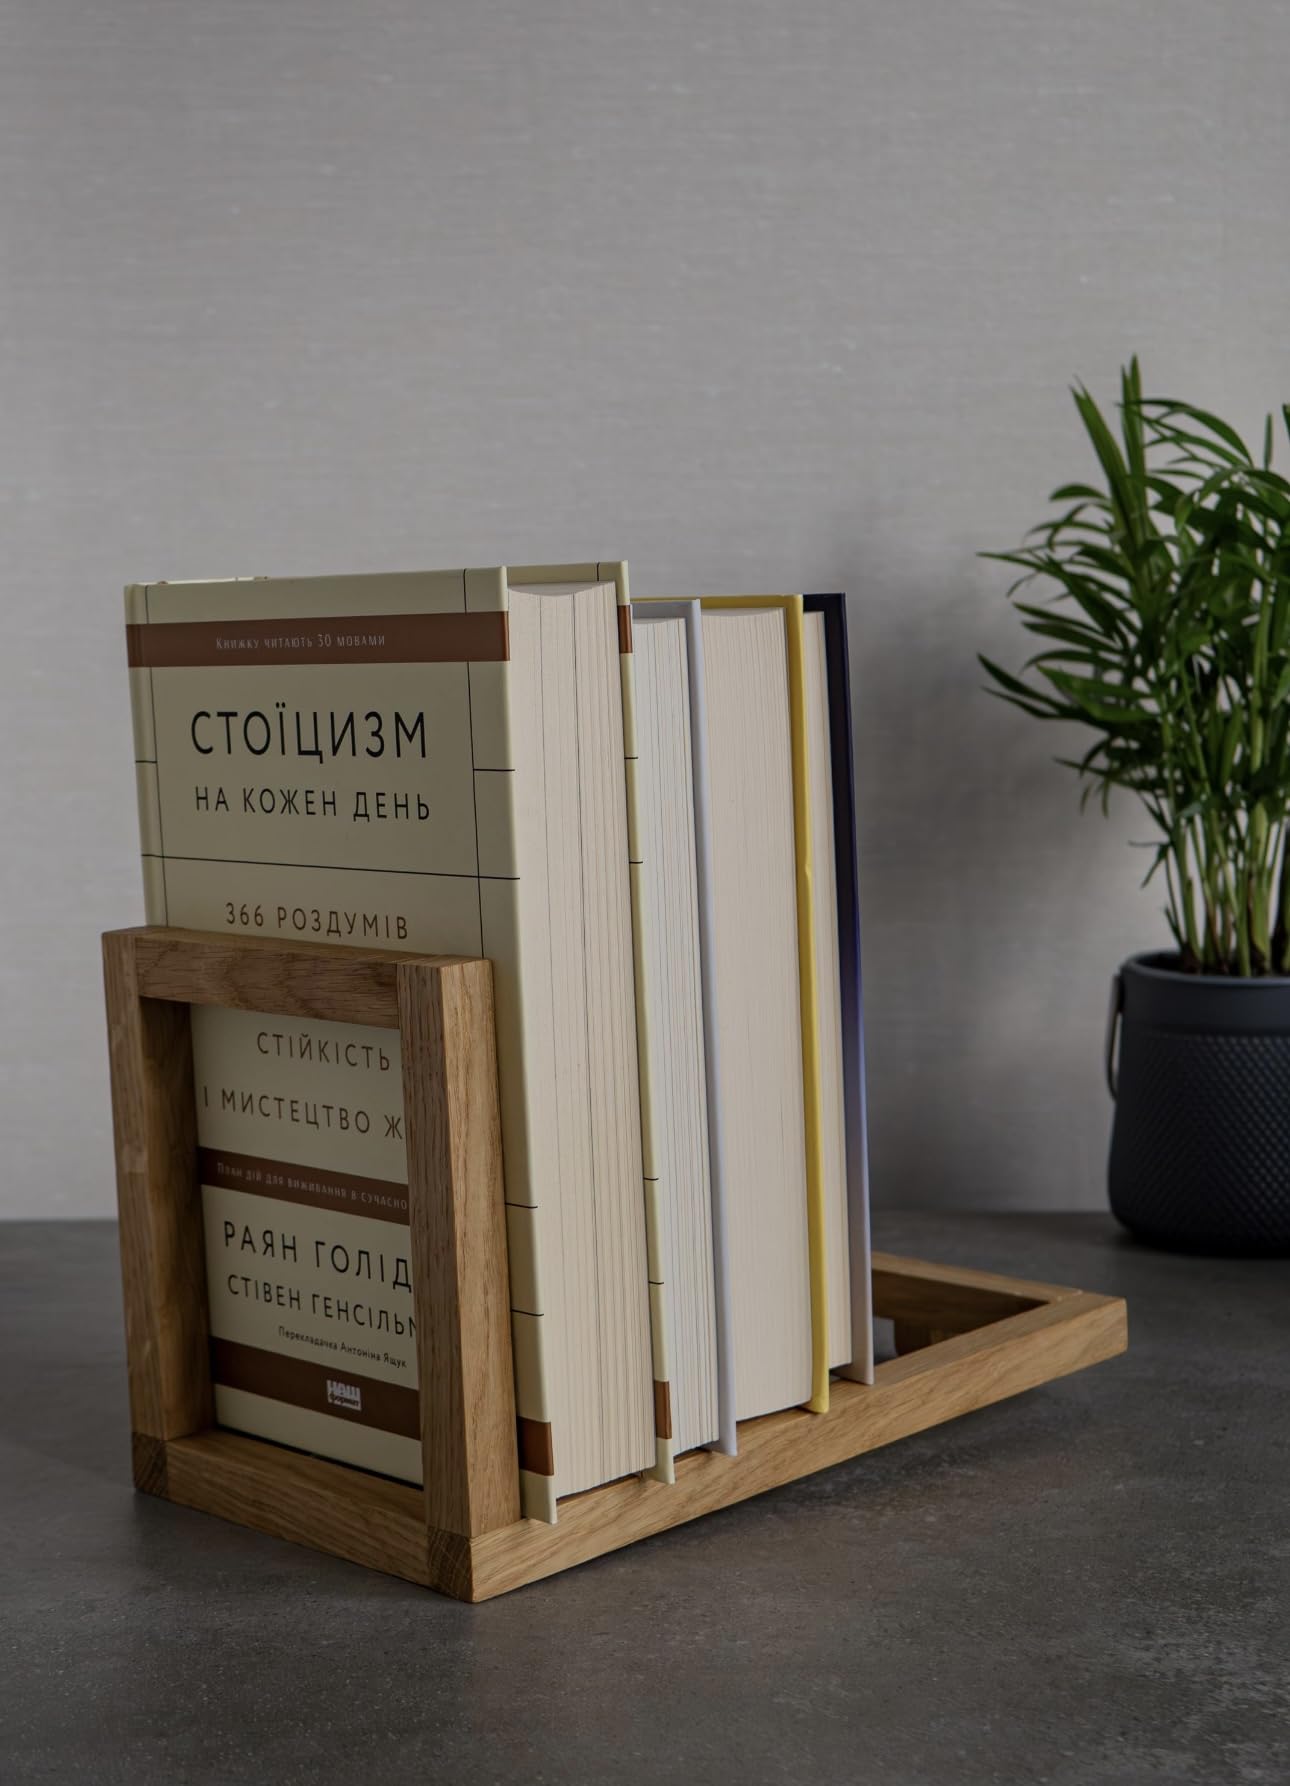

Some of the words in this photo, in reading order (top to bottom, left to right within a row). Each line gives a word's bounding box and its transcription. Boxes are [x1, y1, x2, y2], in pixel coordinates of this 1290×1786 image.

[317, 633, 332, 648] 30
[190, 701, 427, 764] СТОЇЦИЗМ
[195, 786, 229, 813] НА
[242, 787, 337, 816] КОЖЕН
[353, 792, 430, 822] ДЕНЬ
[225, 902, 264, 928] 366
[277, 906, 408, 940] РОЗДУМІВ
[256, 1031, 390, 1071] СТІЙКІСТЬ
[203, 1085, 209, 1108] І
[221, 1088, 370, 1134] МИСТЕЦТВО
[223, 1220, 298, 1263] РАЯН
[315, 1240, 412, 1293] ГОЛІД
[227, 1274, 301, 1311] СТІВЕН
[278, 1325, 338, 1350] Перекладачка
[340, 1342, 381, 1361] Антоніна
[383, 1352, 407, 1369] Ящук
